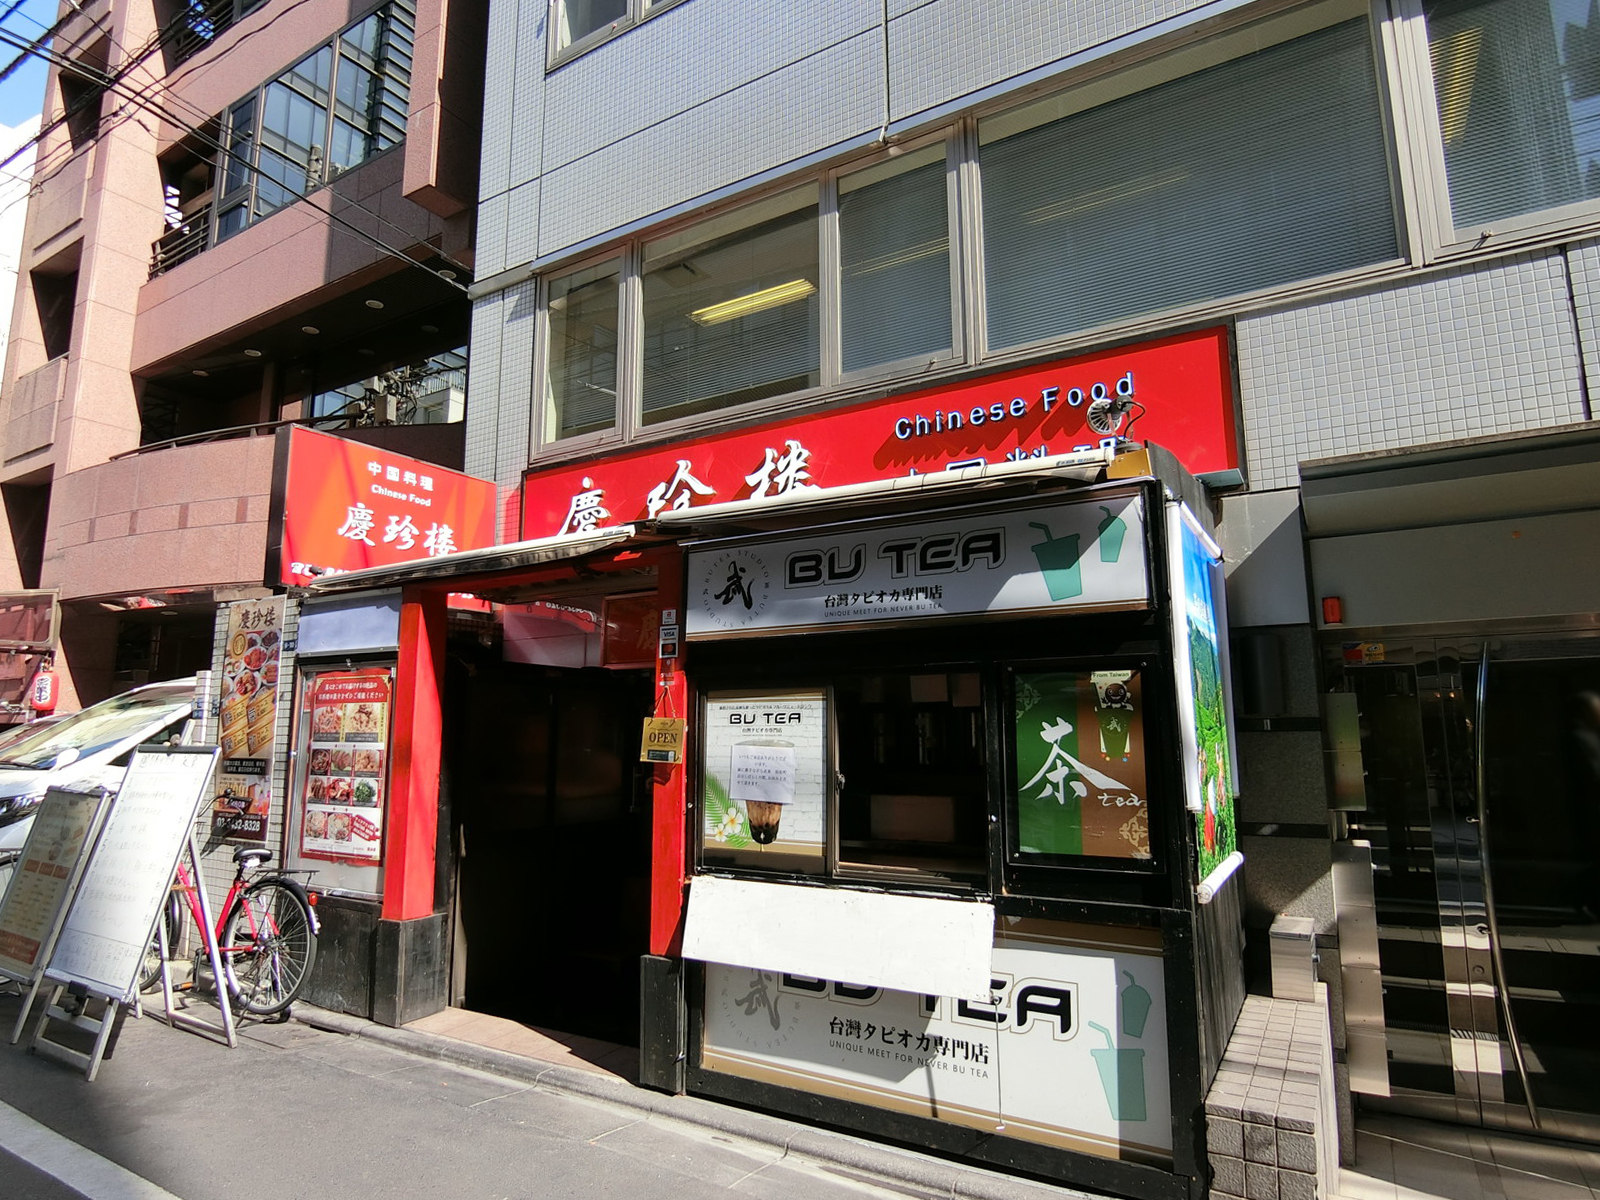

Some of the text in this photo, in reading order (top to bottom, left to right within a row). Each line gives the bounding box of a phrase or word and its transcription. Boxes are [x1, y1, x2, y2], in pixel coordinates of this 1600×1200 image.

[895, 371, 1135, 440] Chinese Food
[368, 461, 434, 491] 中国料理
[371, 484, 431, 507] Chinese Food
[338, 502, 458, 557] 慶珍楼
[787, 529, 1003, 587] BU TEA
[824, 585, 944, 609] 台灣タピオカ専門店
[824, 609, 851, 618] UNIQUE
[853, 608, 872, 616] MEET
[889, 605, 914, 613] NEVER
[927, 602, 943, 610] TEA
[730, 712, 802, 725] BU TEA
[649, 731, 678, 744] OPEN
[1018, 716, 1132, 805] 茶
[1097, 792, 1148, 807] tea
[829, 1016, 989, 1065] 台灣タピオカ専門店
[829, 1039, 989, 1079] UNIQUE MEET FOR NEVER BU TEA
